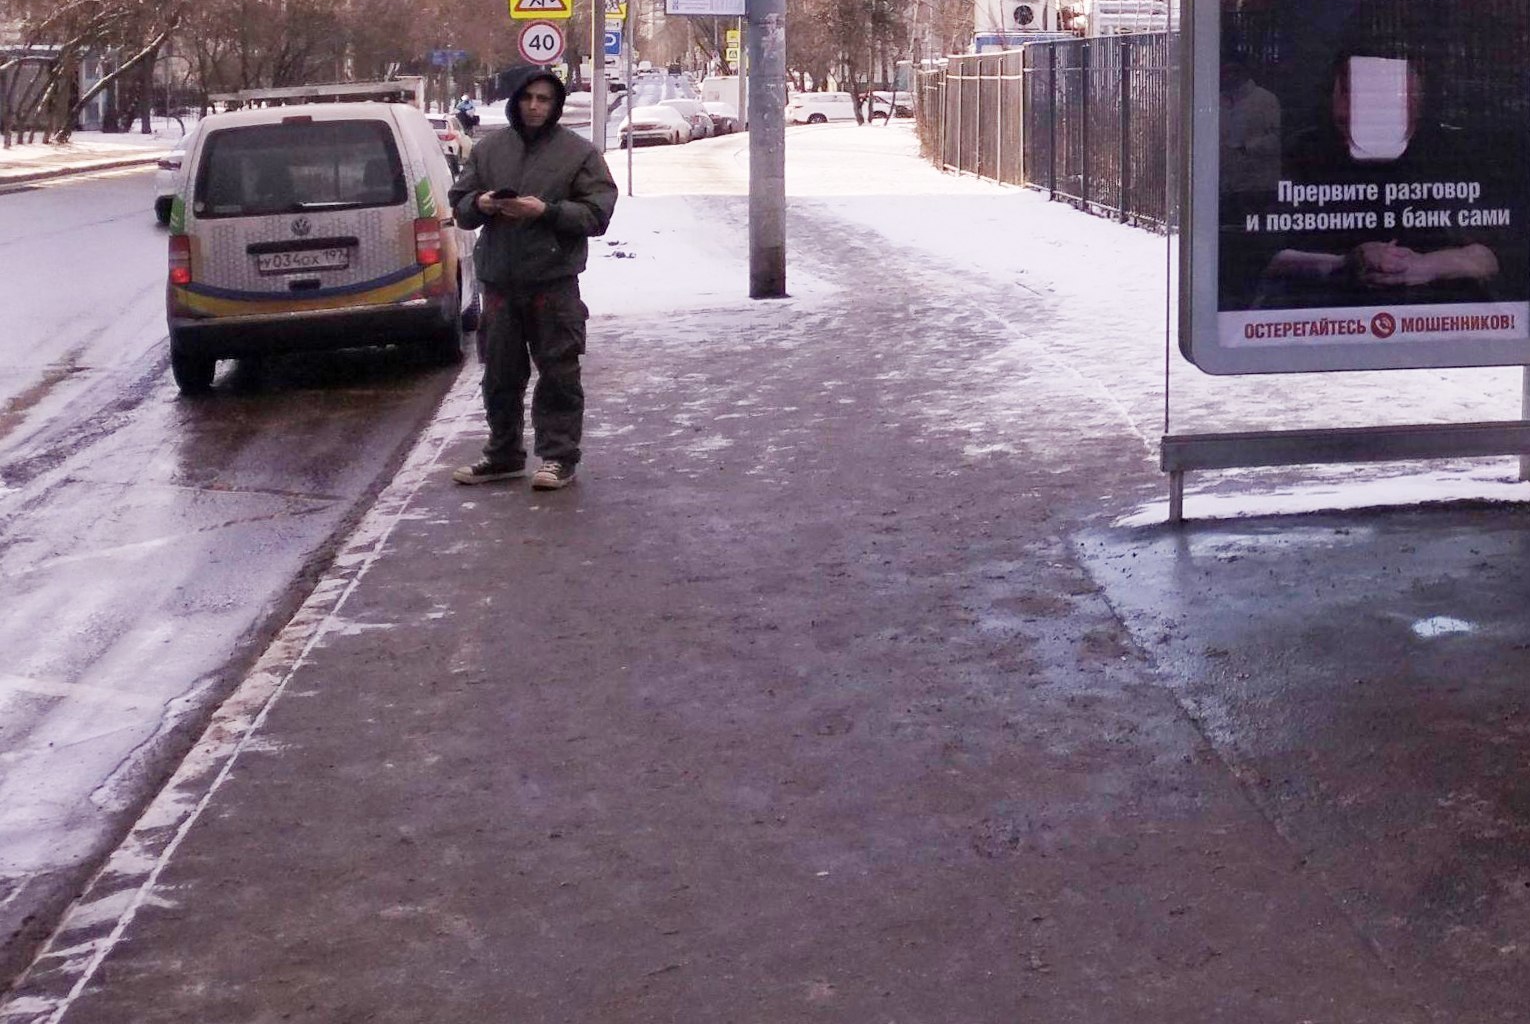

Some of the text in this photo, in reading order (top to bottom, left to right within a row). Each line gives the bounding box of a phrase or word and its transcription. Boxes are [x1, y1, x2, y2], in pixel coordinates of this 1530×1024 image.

[528, 33, 555, 51] 40
[1278, 180, 1481, 207] Прервите разговор
[1246, 205, 1511, 232] и позвоните в банк сами
[1244, 314, 1515, 339] ОСТЕРЕГАЙТЕСЬ МОШЕННИКОВ!
